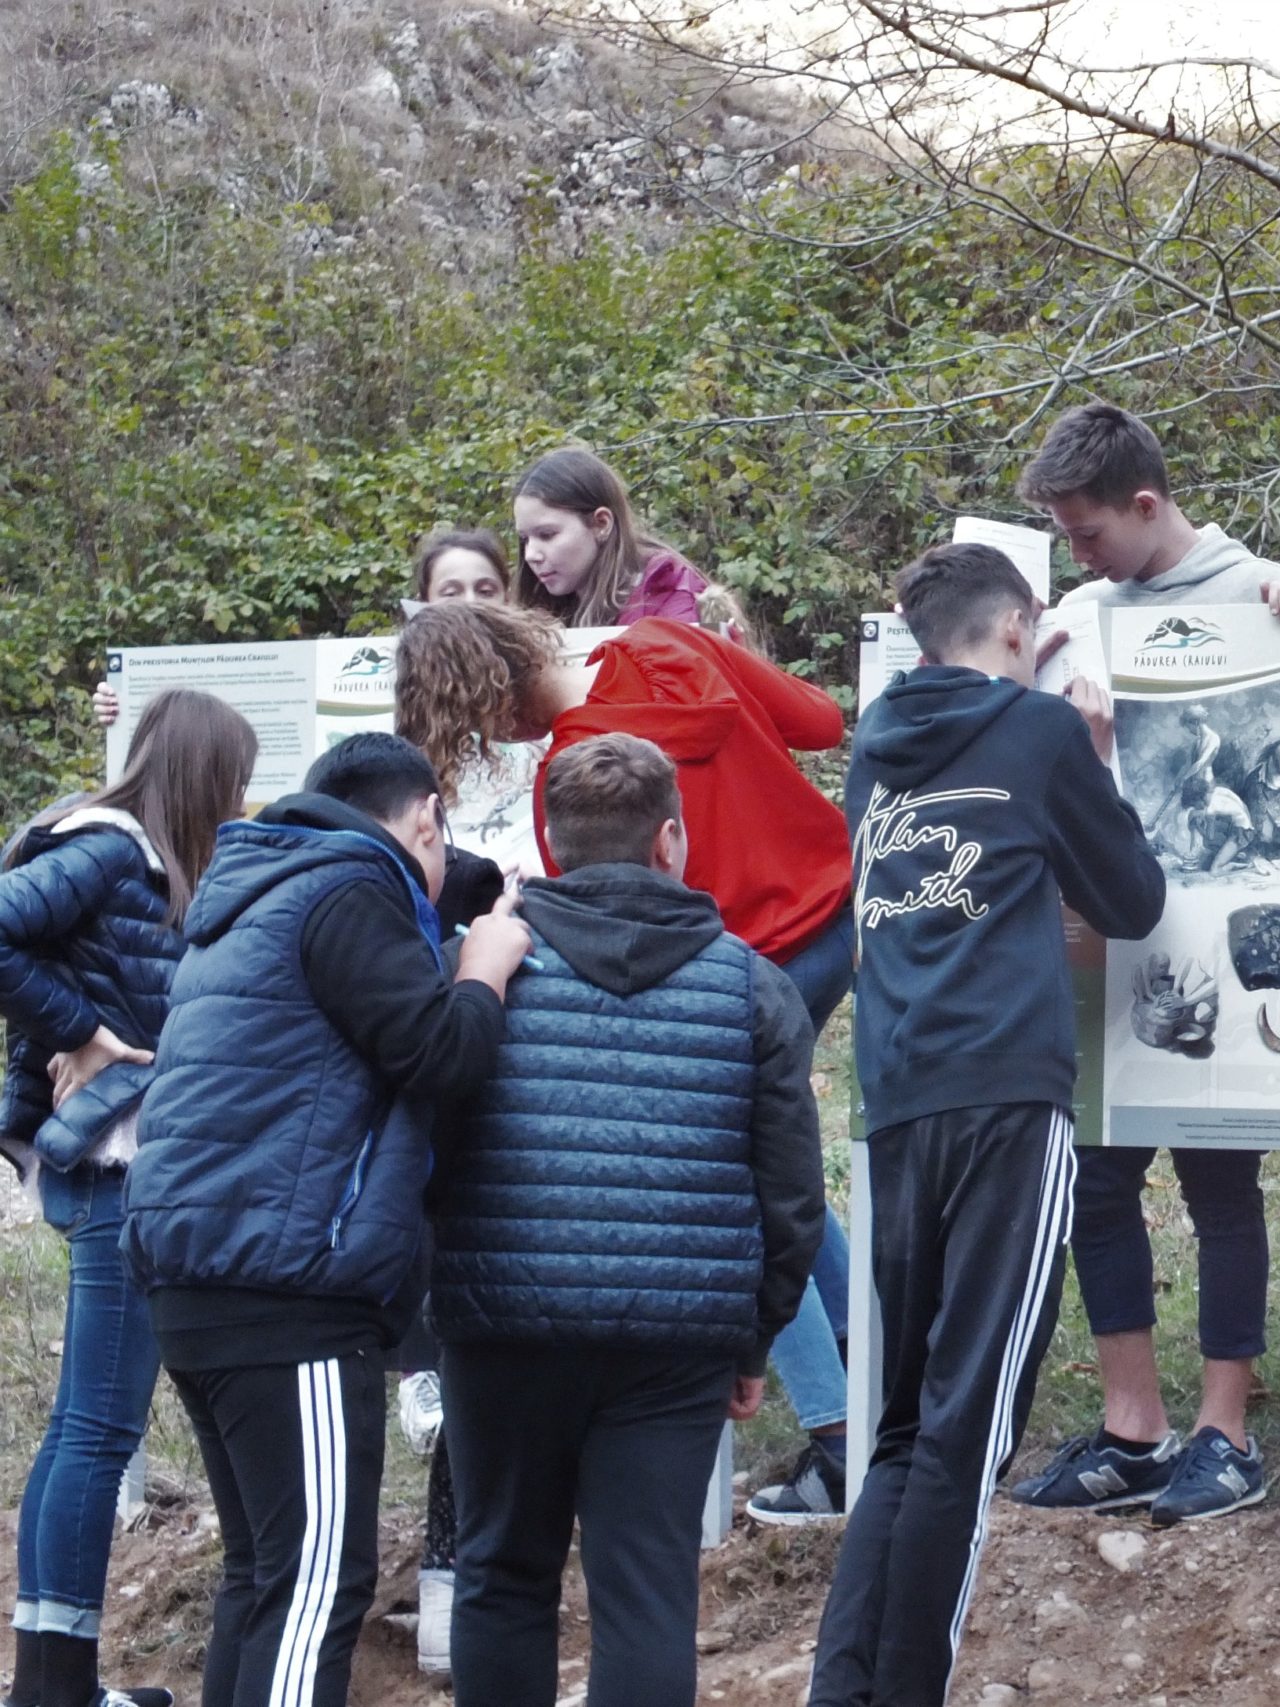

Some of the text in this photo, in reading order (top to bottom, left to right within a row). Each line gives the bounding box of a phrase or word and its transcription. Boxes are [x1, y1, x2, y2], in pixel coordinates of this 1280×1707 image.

[1134, 652, 1227, 667] PĂDUREA CRAIULUI
[1077, 1464, 1129, 1500] N
[1216, 1463, 1250, 1501] N
